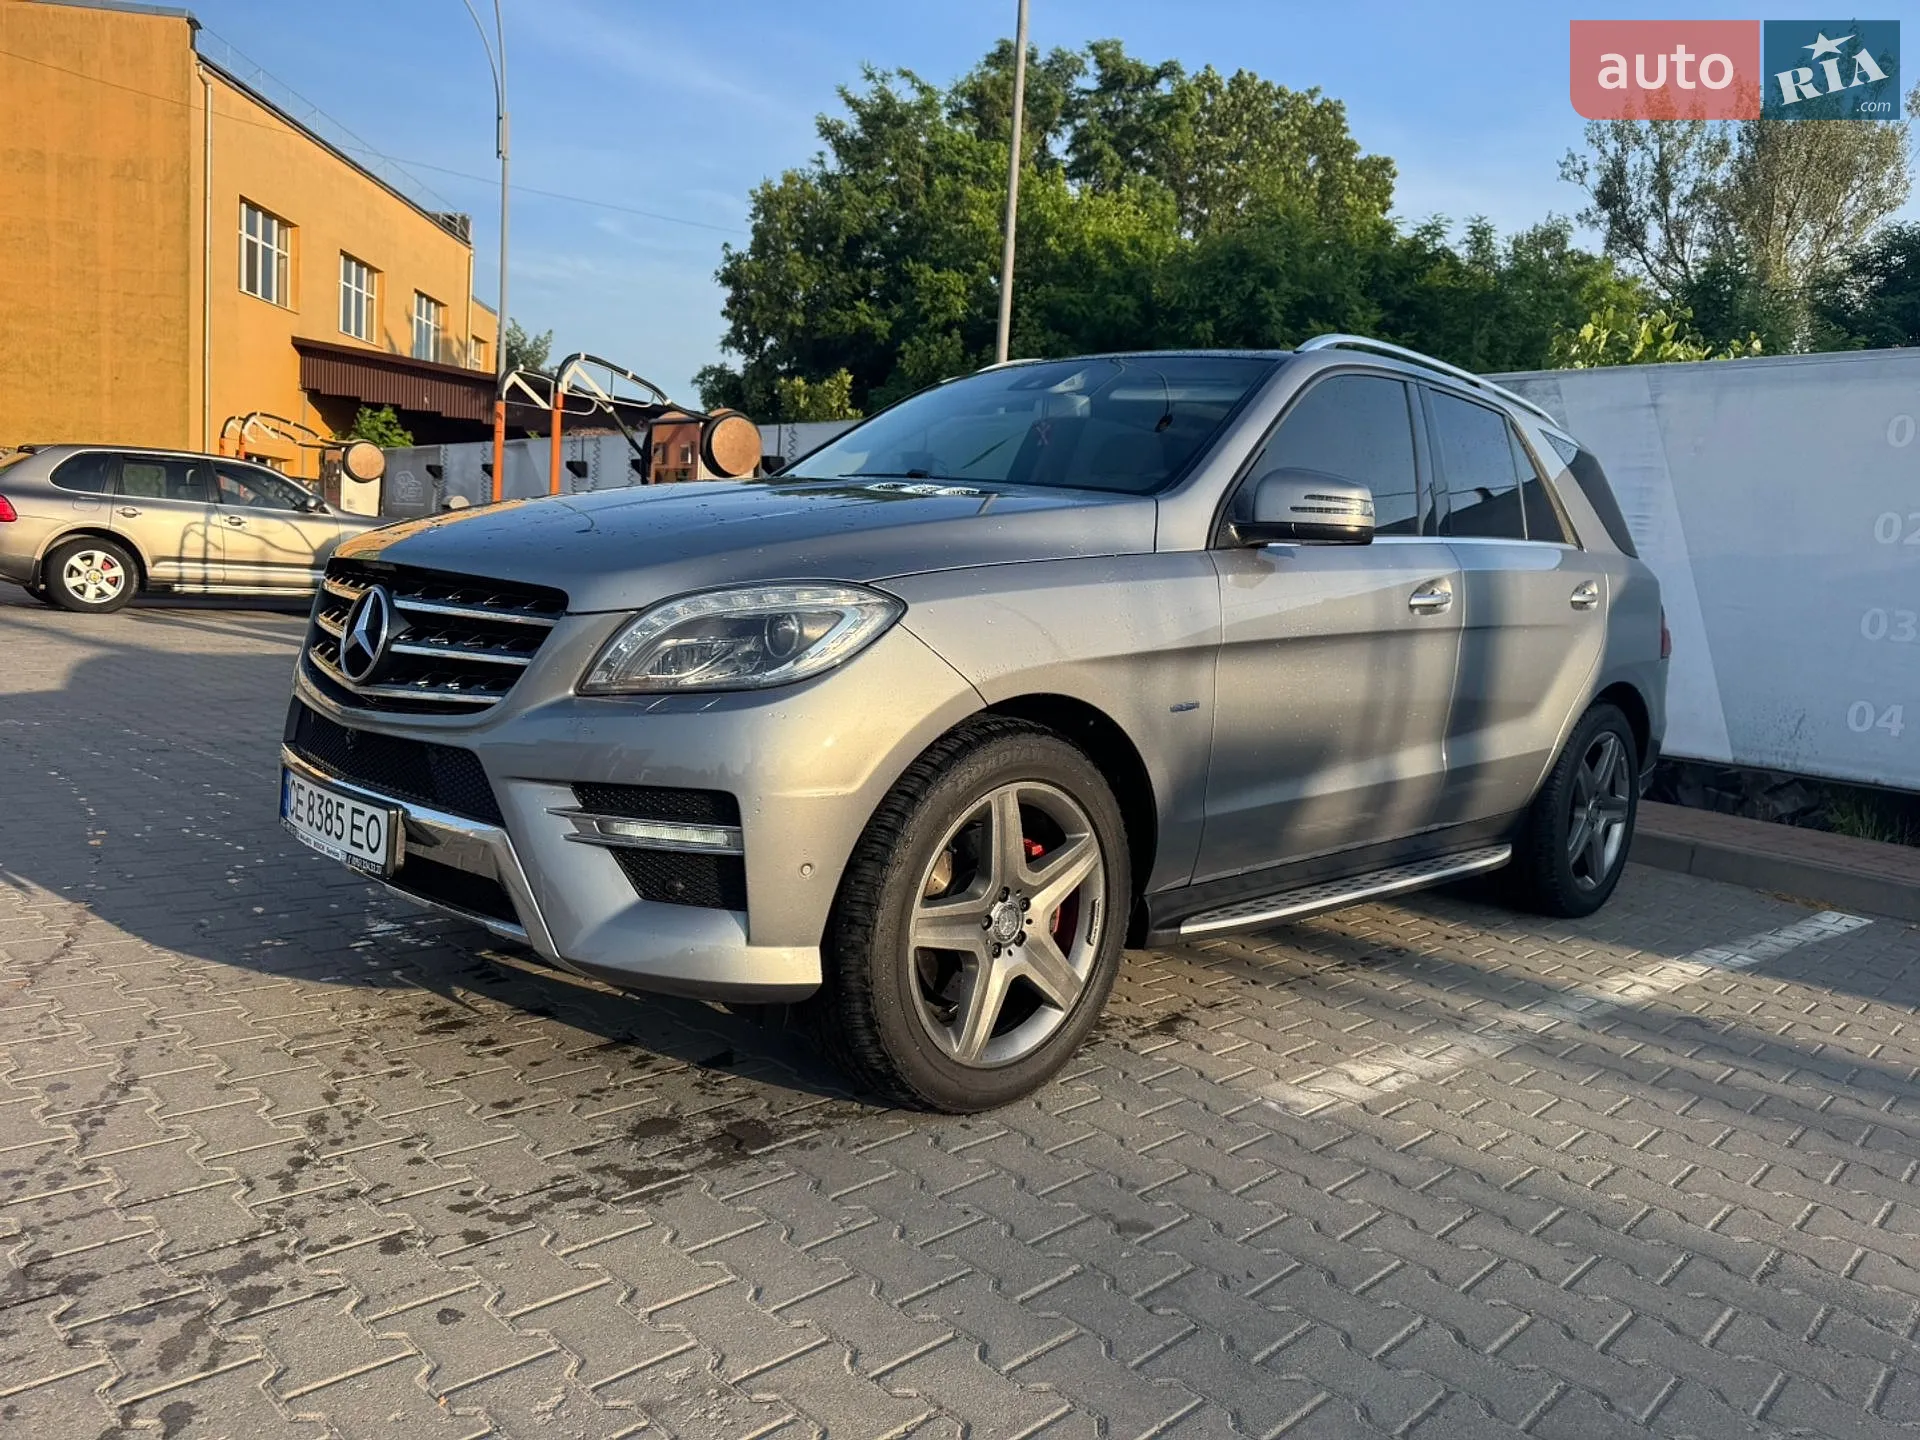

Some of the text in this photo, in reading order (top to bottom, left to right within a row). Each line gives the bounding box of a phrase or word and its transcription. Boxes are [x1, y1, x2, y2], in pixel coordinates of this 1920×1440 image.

[1874, 511, 1920, 545] 02
[1860, 608, 1918, 642] 03
[1846, 700, 1905, 737] 04
[289, 779, 305, 822] CE
[307, 790, 345, 840] 8385
[350, 807, 382, 854] EO
